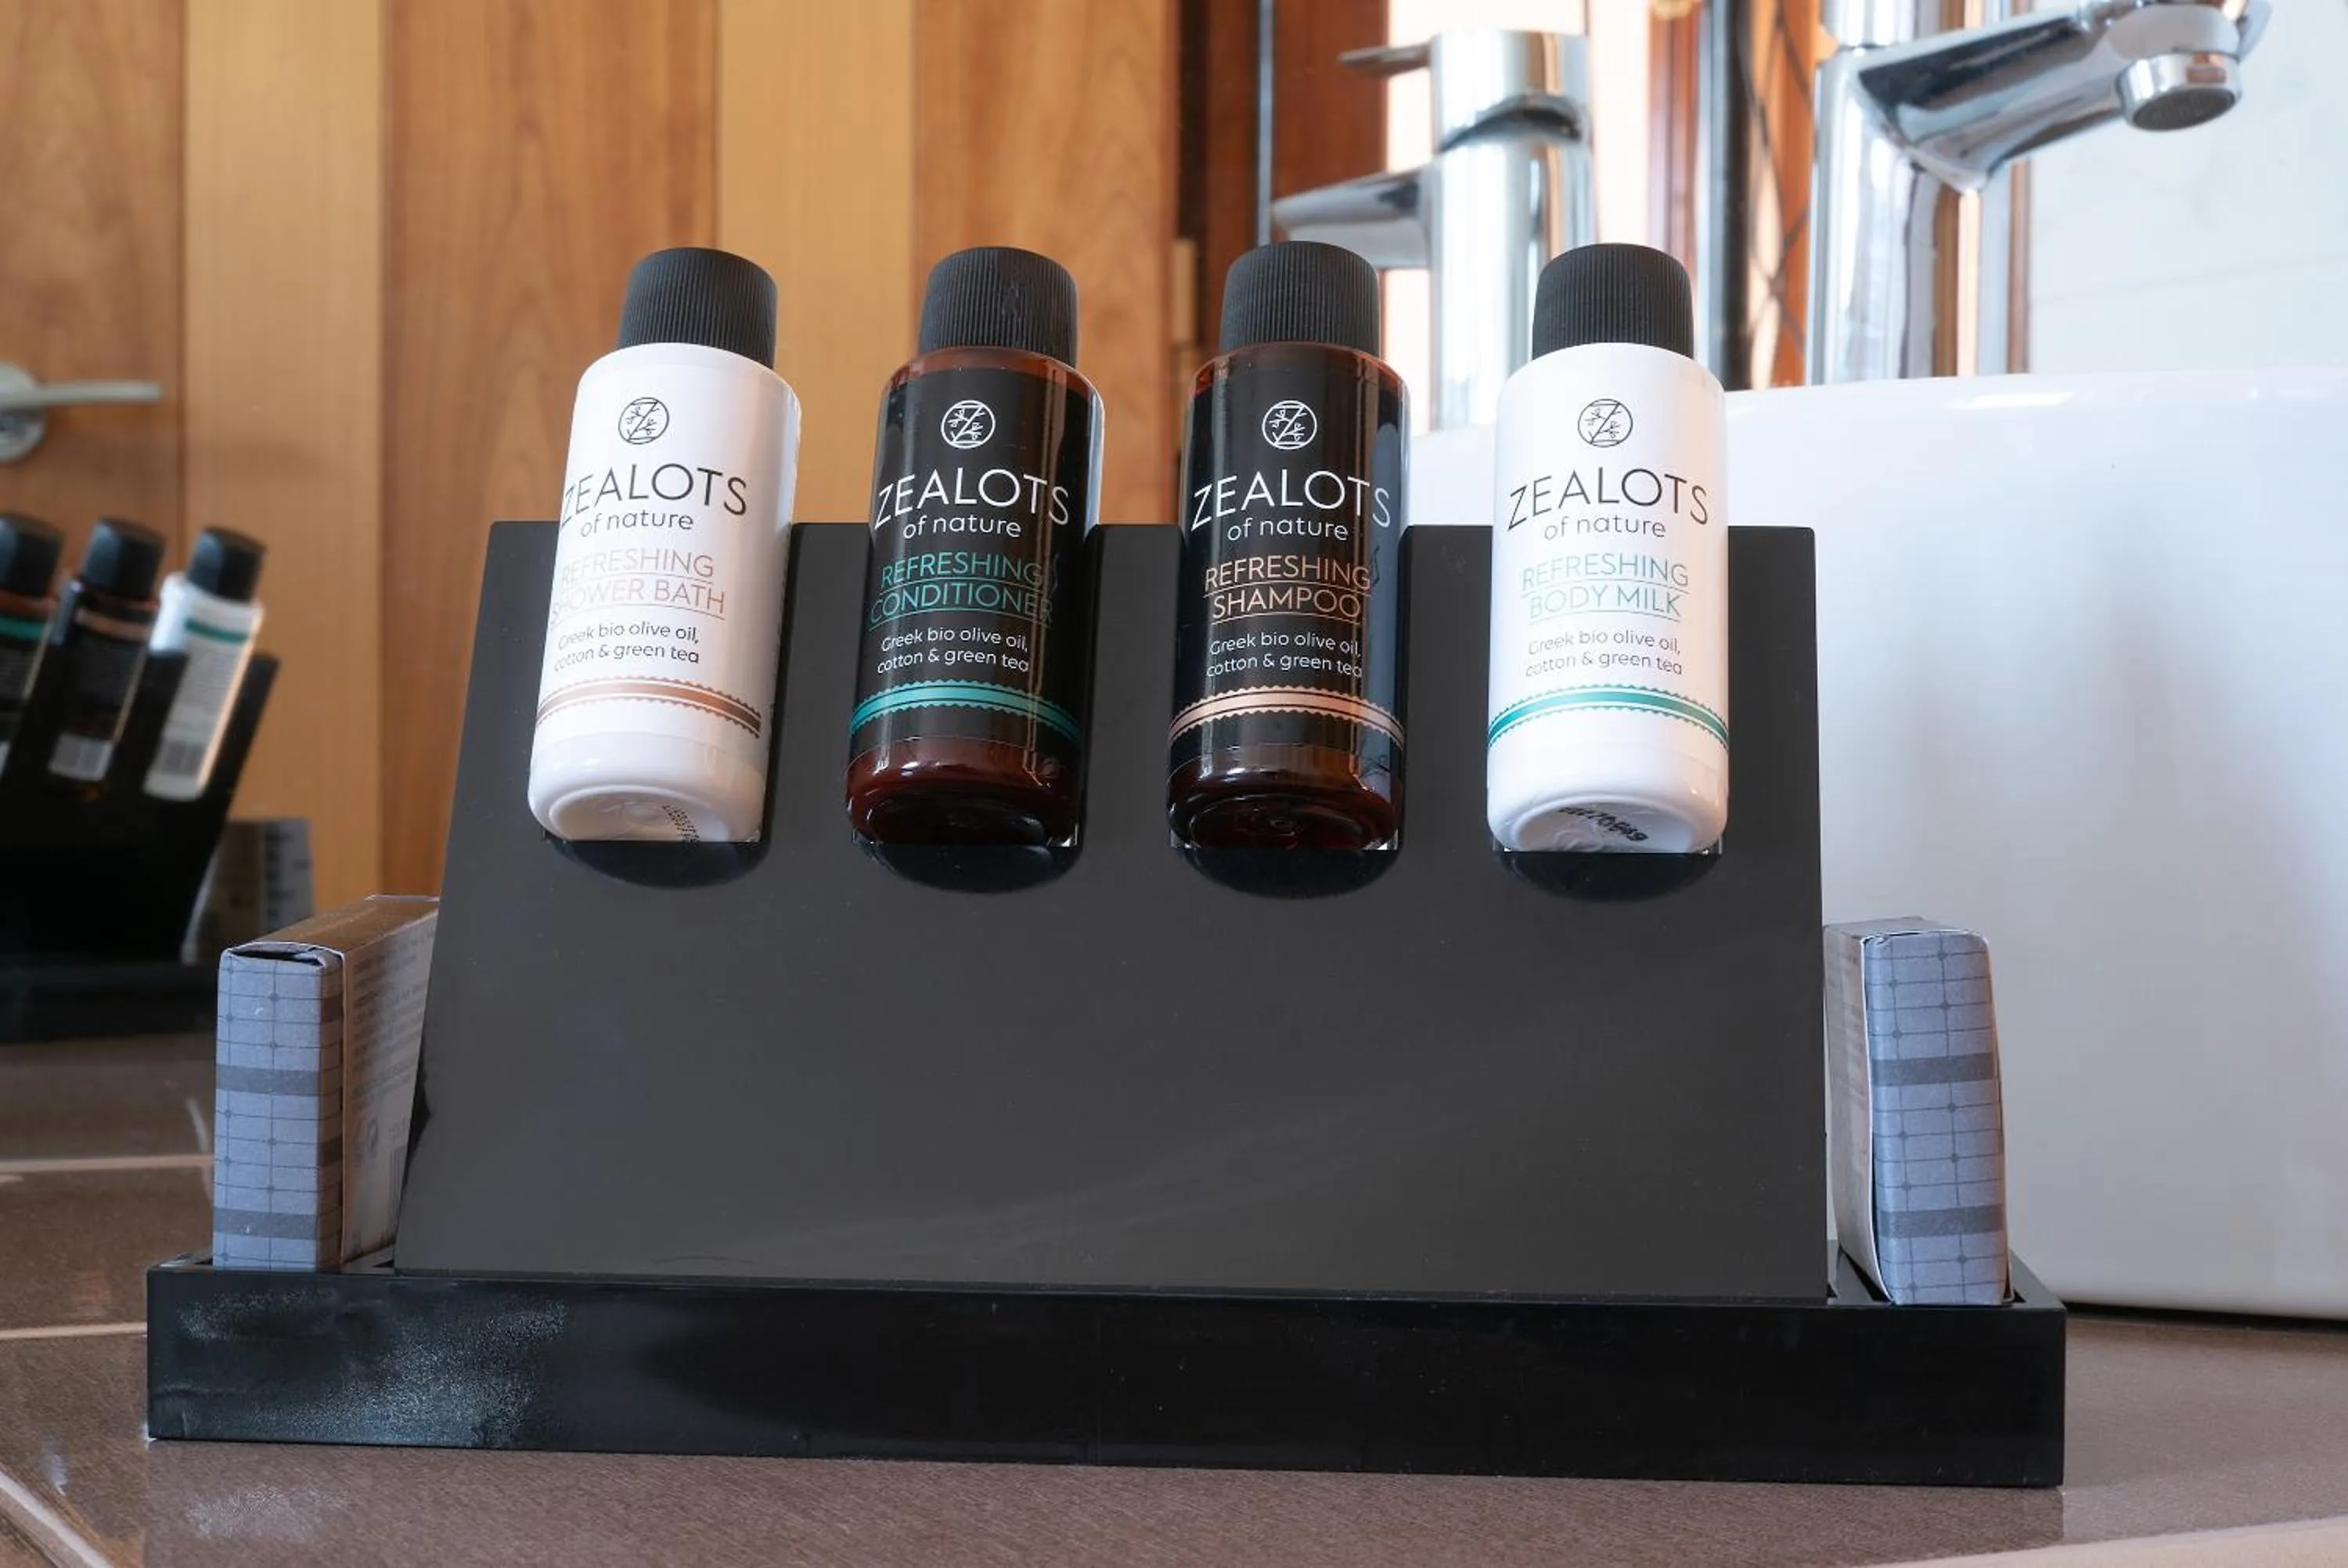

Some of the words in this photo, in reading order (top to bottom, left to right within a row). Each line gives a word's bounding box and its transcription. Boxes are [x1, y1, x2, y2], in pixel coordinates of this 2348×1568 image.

[560, 462, 747, 527] ZEALOTS
[874, 467, 1069, 530] ZEALOTS
[1190, 469, 1390, 532] ZEALOTS
[1507, 466, 1709, 532] ZEALOTS
[580, 512, 606, 538] of
[608, 510, 693, 531] nature
[902, 515, 927, 539] of
[932, 516, 1021, 538] nature
[1226, 517, 1253, 541] of
[1259, 518, 1349, 541] nature
[1544, 515, 1569, 541] of
[1577, 514, 1666, 538] nature
[561, 548, 714, 584] REFRESHING
[881, 551, 1043, 589] REFRESHING
[1205, 554, 1371, 592] REFRESHING
[1522, 552, 1689, 592] REFRESHING
[654, 581, 725, 614] BATH
[870, 581, 1052, 624] CONDITIONER
[1213, 586, 1361, 620] SHAMPOO
[1529, 584, 1608, 620] BODY
[1617, 584, 1681, 617] MILK
[558, 624, 594, 650] Greek
[599, 622, 625, 638] bio
[629, 621, 671, 638] olive
[675, 625, 699, 645] oil,
[881, 625, 923, 653] Greek
[927, 627, 955, 642] bio
[960, 627, 1001, 644] olive
[1006, 633, 1028, 653] oil,
[1209, 632, 1256, 656] Greek
[1261, 631, 1289, 646] bio
[1294, 632, 1336, 649] olive
[1339, 638, 1362, 658] oil,
[1528, 630, 1574, 655] Greek
[1579, 630, 1608, 645] bio
[1613, 631, 1655, 648] olive
[1659, 635, 1681, 655] oil,
[599, 644, 610, 658] &
[614, 643, 665, 661] green
[671, 646, 699, 664] tea
[877, 649, 923, 674] cotton
[927, 647, 940, 663] &
[944, 647, 996, 666] green
[1002, 652, 1029, 673] tea
[1206, 654, 1258, 678] cotton
[1262, 653, 1275, 668] &
[1279, 653, 1331, 672] green
[1336, 658, 1363, 678] tea
[1525, 652, 1576, 677] cotton
[1581, 651, 1594, 666] &
[1598, 651, 1651, 669] green
[1656, 655, 1683, 675] tea
